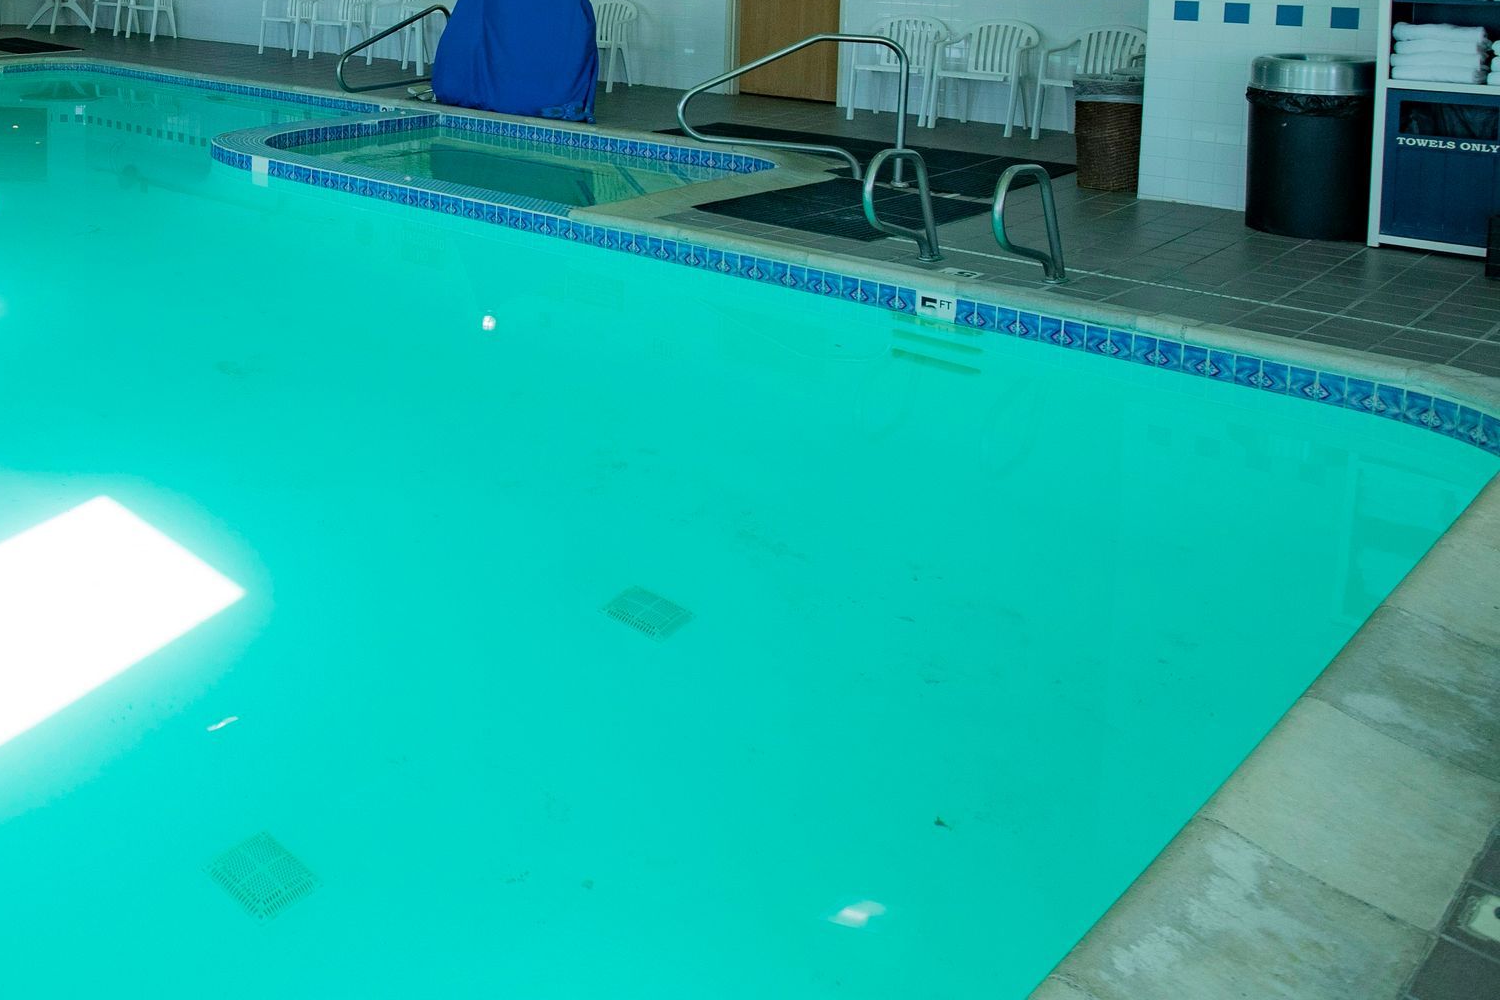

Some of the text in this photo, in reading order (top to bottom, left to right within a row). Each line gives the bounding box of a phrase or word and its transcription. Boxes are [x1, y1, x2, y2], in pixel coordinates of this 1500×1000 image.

[1396, 136, 1500, 153] TOWELS ONLY
[940, 299, 952, 310] FT
